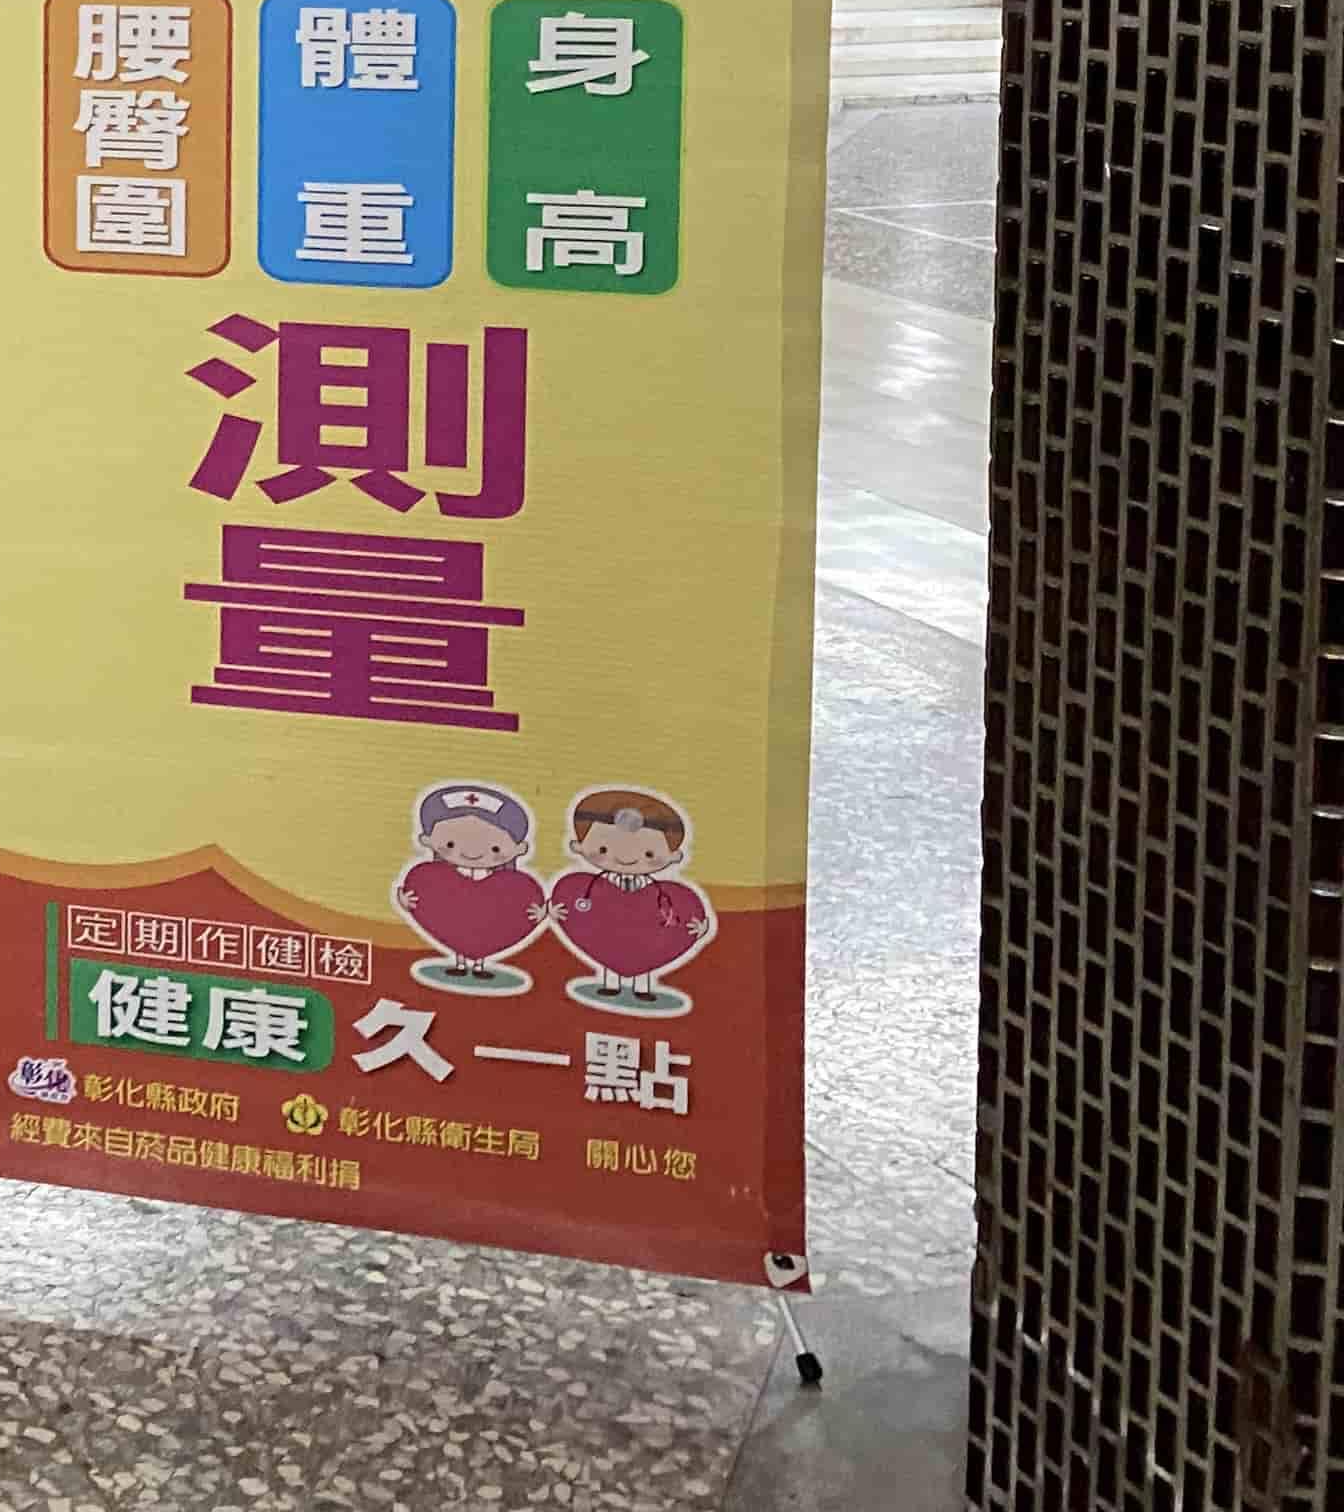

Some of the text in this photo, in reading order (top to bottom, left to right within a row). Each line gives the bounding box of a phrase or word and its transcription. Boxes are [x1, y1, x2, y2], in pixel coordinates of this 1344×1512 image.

[73, 4, 192, 259] 腰臀圍
[296, 6, 420, 267] 體重
[525, 11, 650, 277] 身高
[183, 312, 530, 734] 測量
[74, 912, 368, 981] 定期作健檢
[10, 1111, 362, 1191] 經費來自菸品健康福利捐
[83, 1074, 241, 1123] 彰化縣政府
[339, 1105, 541, 1161] 彰化縣衛生局
